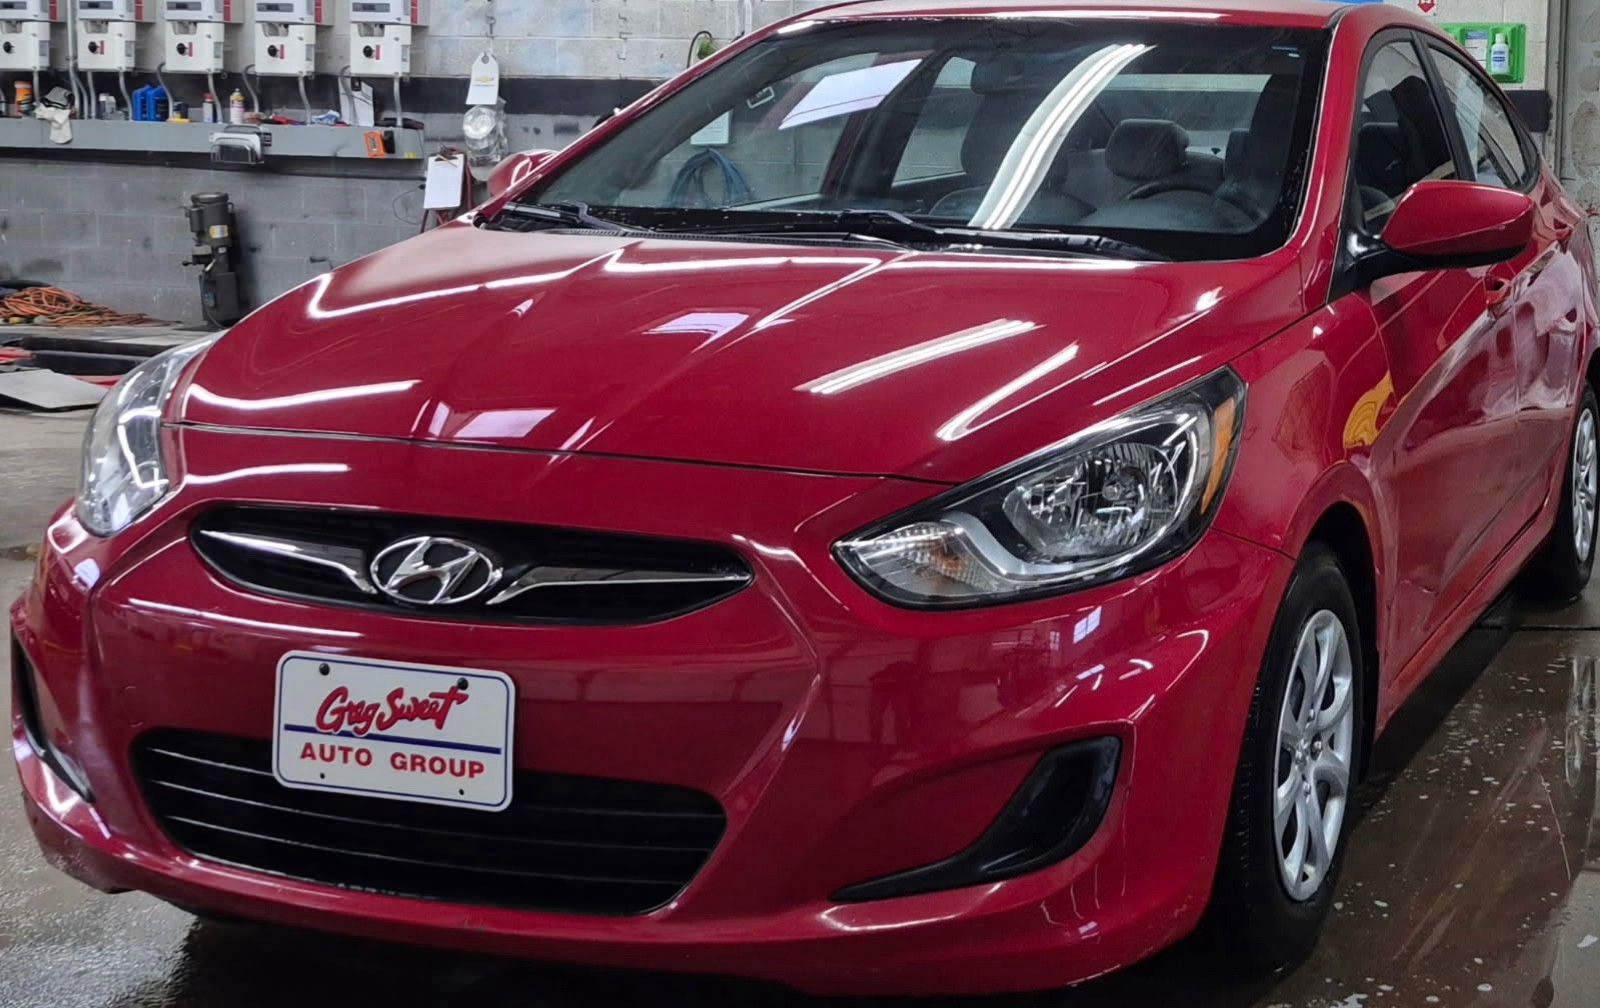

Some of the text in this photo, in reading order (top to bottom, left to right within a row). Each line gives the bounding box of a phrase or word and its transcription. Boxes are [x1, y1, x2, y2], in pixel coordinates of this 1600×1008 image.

[315, 686, 469, 735] Greg Sweet
[300, 742, 485, 779] AUTO GROUP
